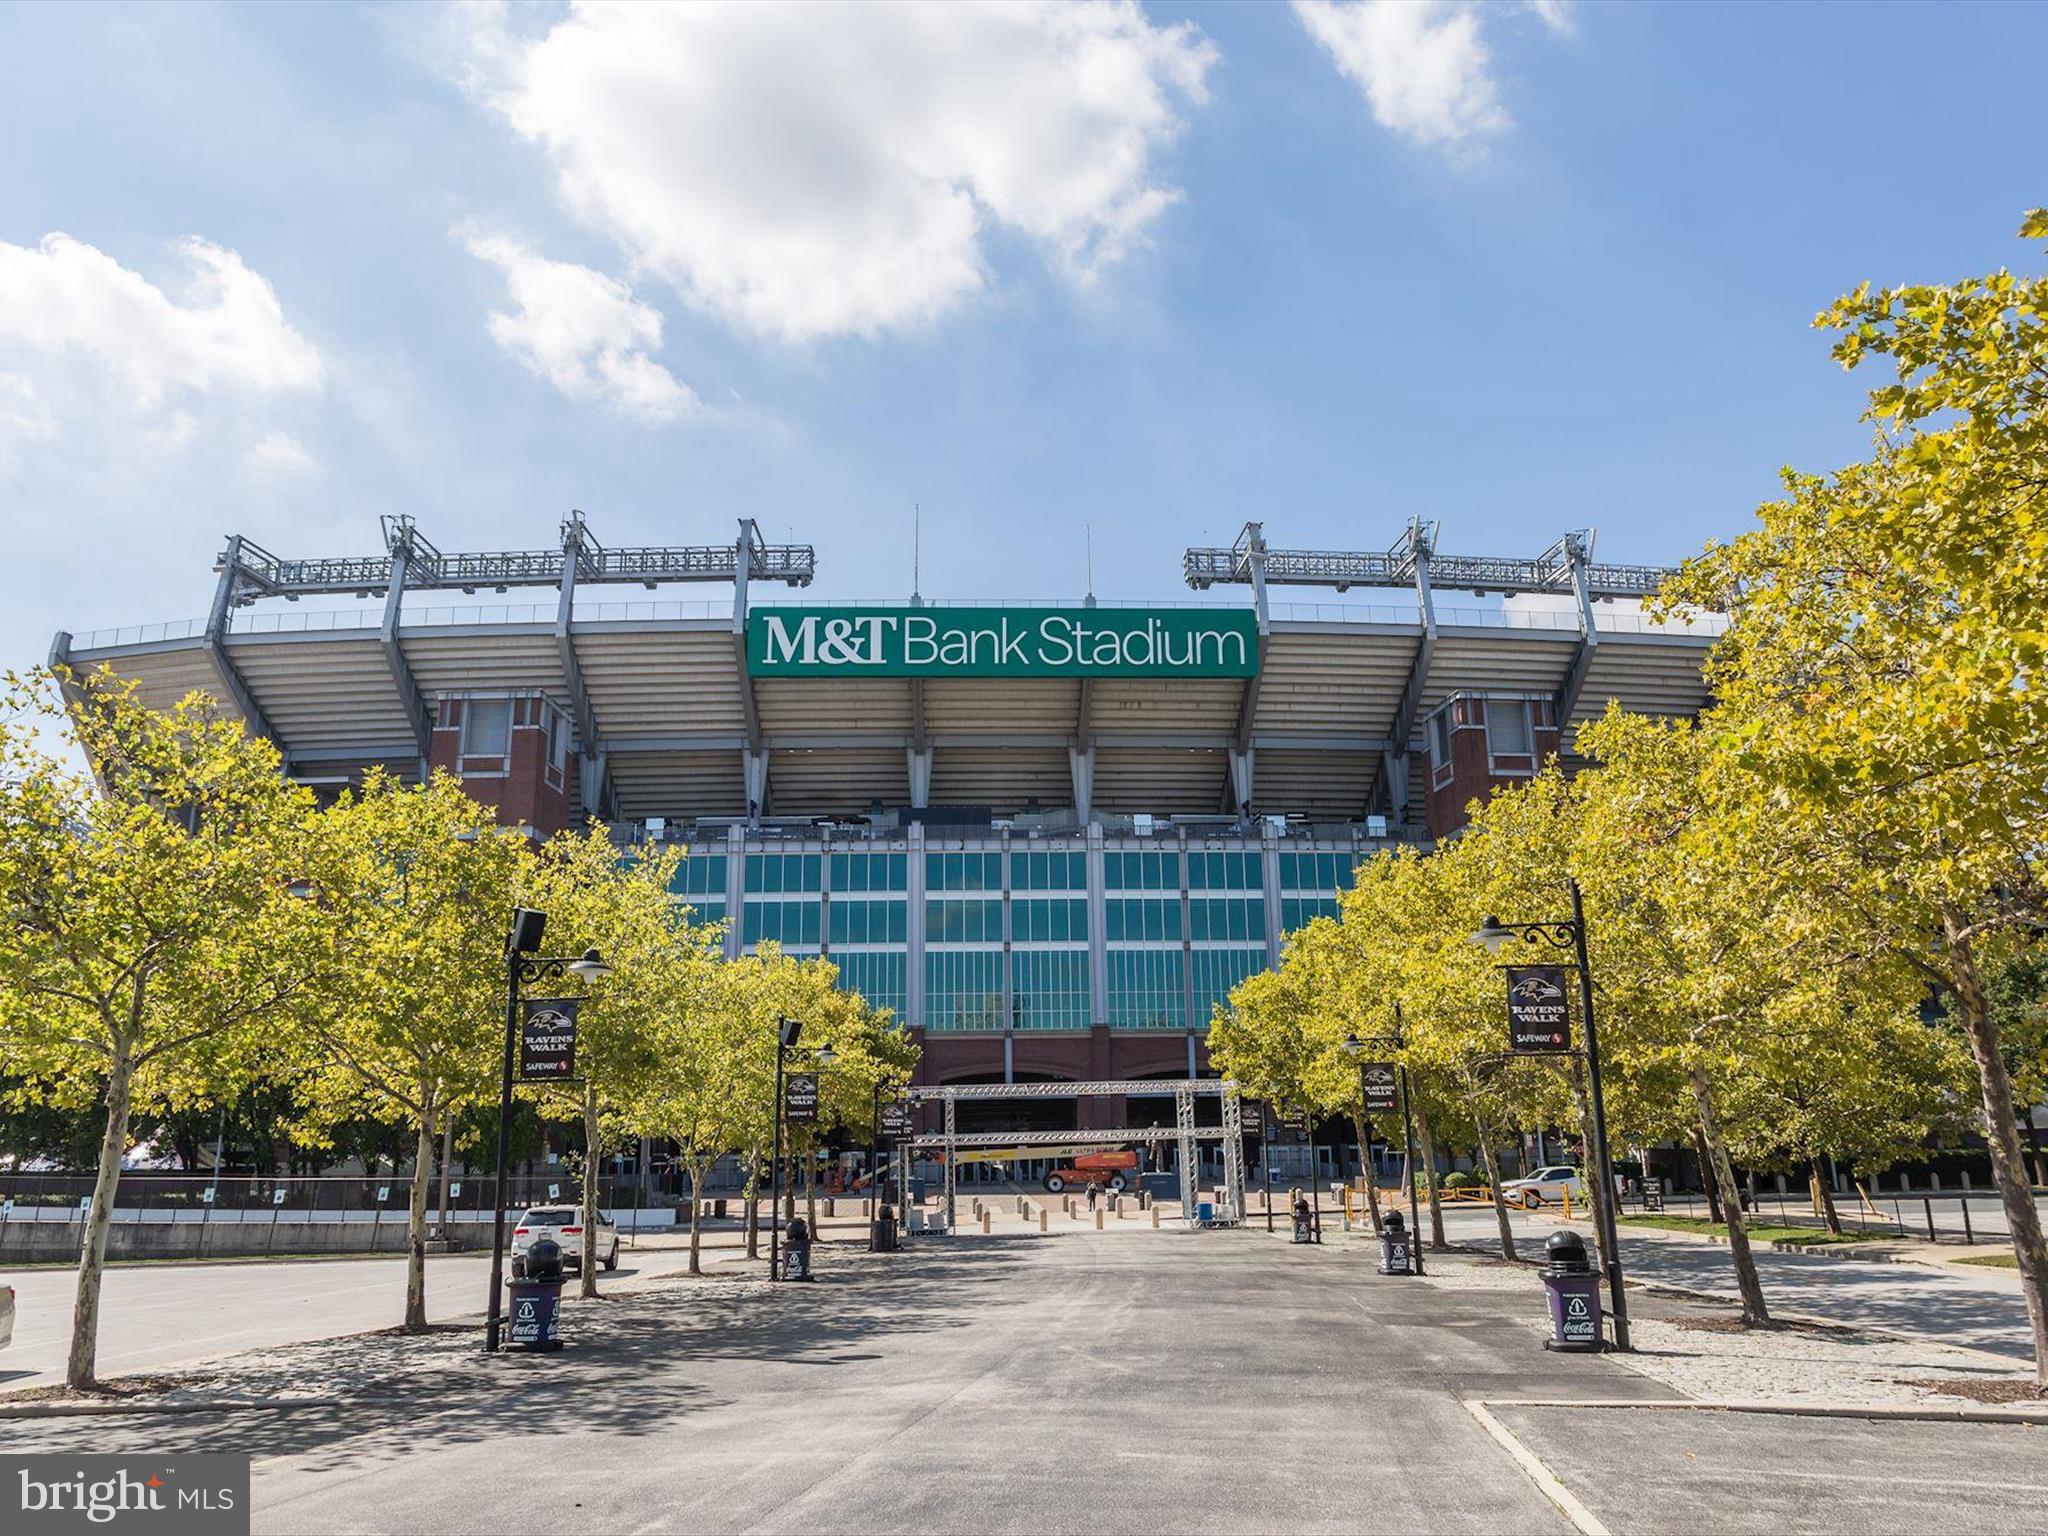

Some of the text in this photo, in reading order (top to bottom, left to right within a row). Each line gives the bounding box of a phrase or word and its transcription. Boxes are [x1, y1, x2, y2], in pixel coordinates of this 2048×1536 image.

[762, 616, 1246, 666] M&T Bank Stadium
[1511, 1005, 1566, 1014] RAVENS
[1517, 1014, 1560, 1022] WALK
[524, 1035, 573, 1044] RAVENS
[1516, 1033, 1551, 1042] SAFEWAY
[529, 1043, 568, 1052] WALK
[526, 1062, 558, 1071] SAFEWAY
